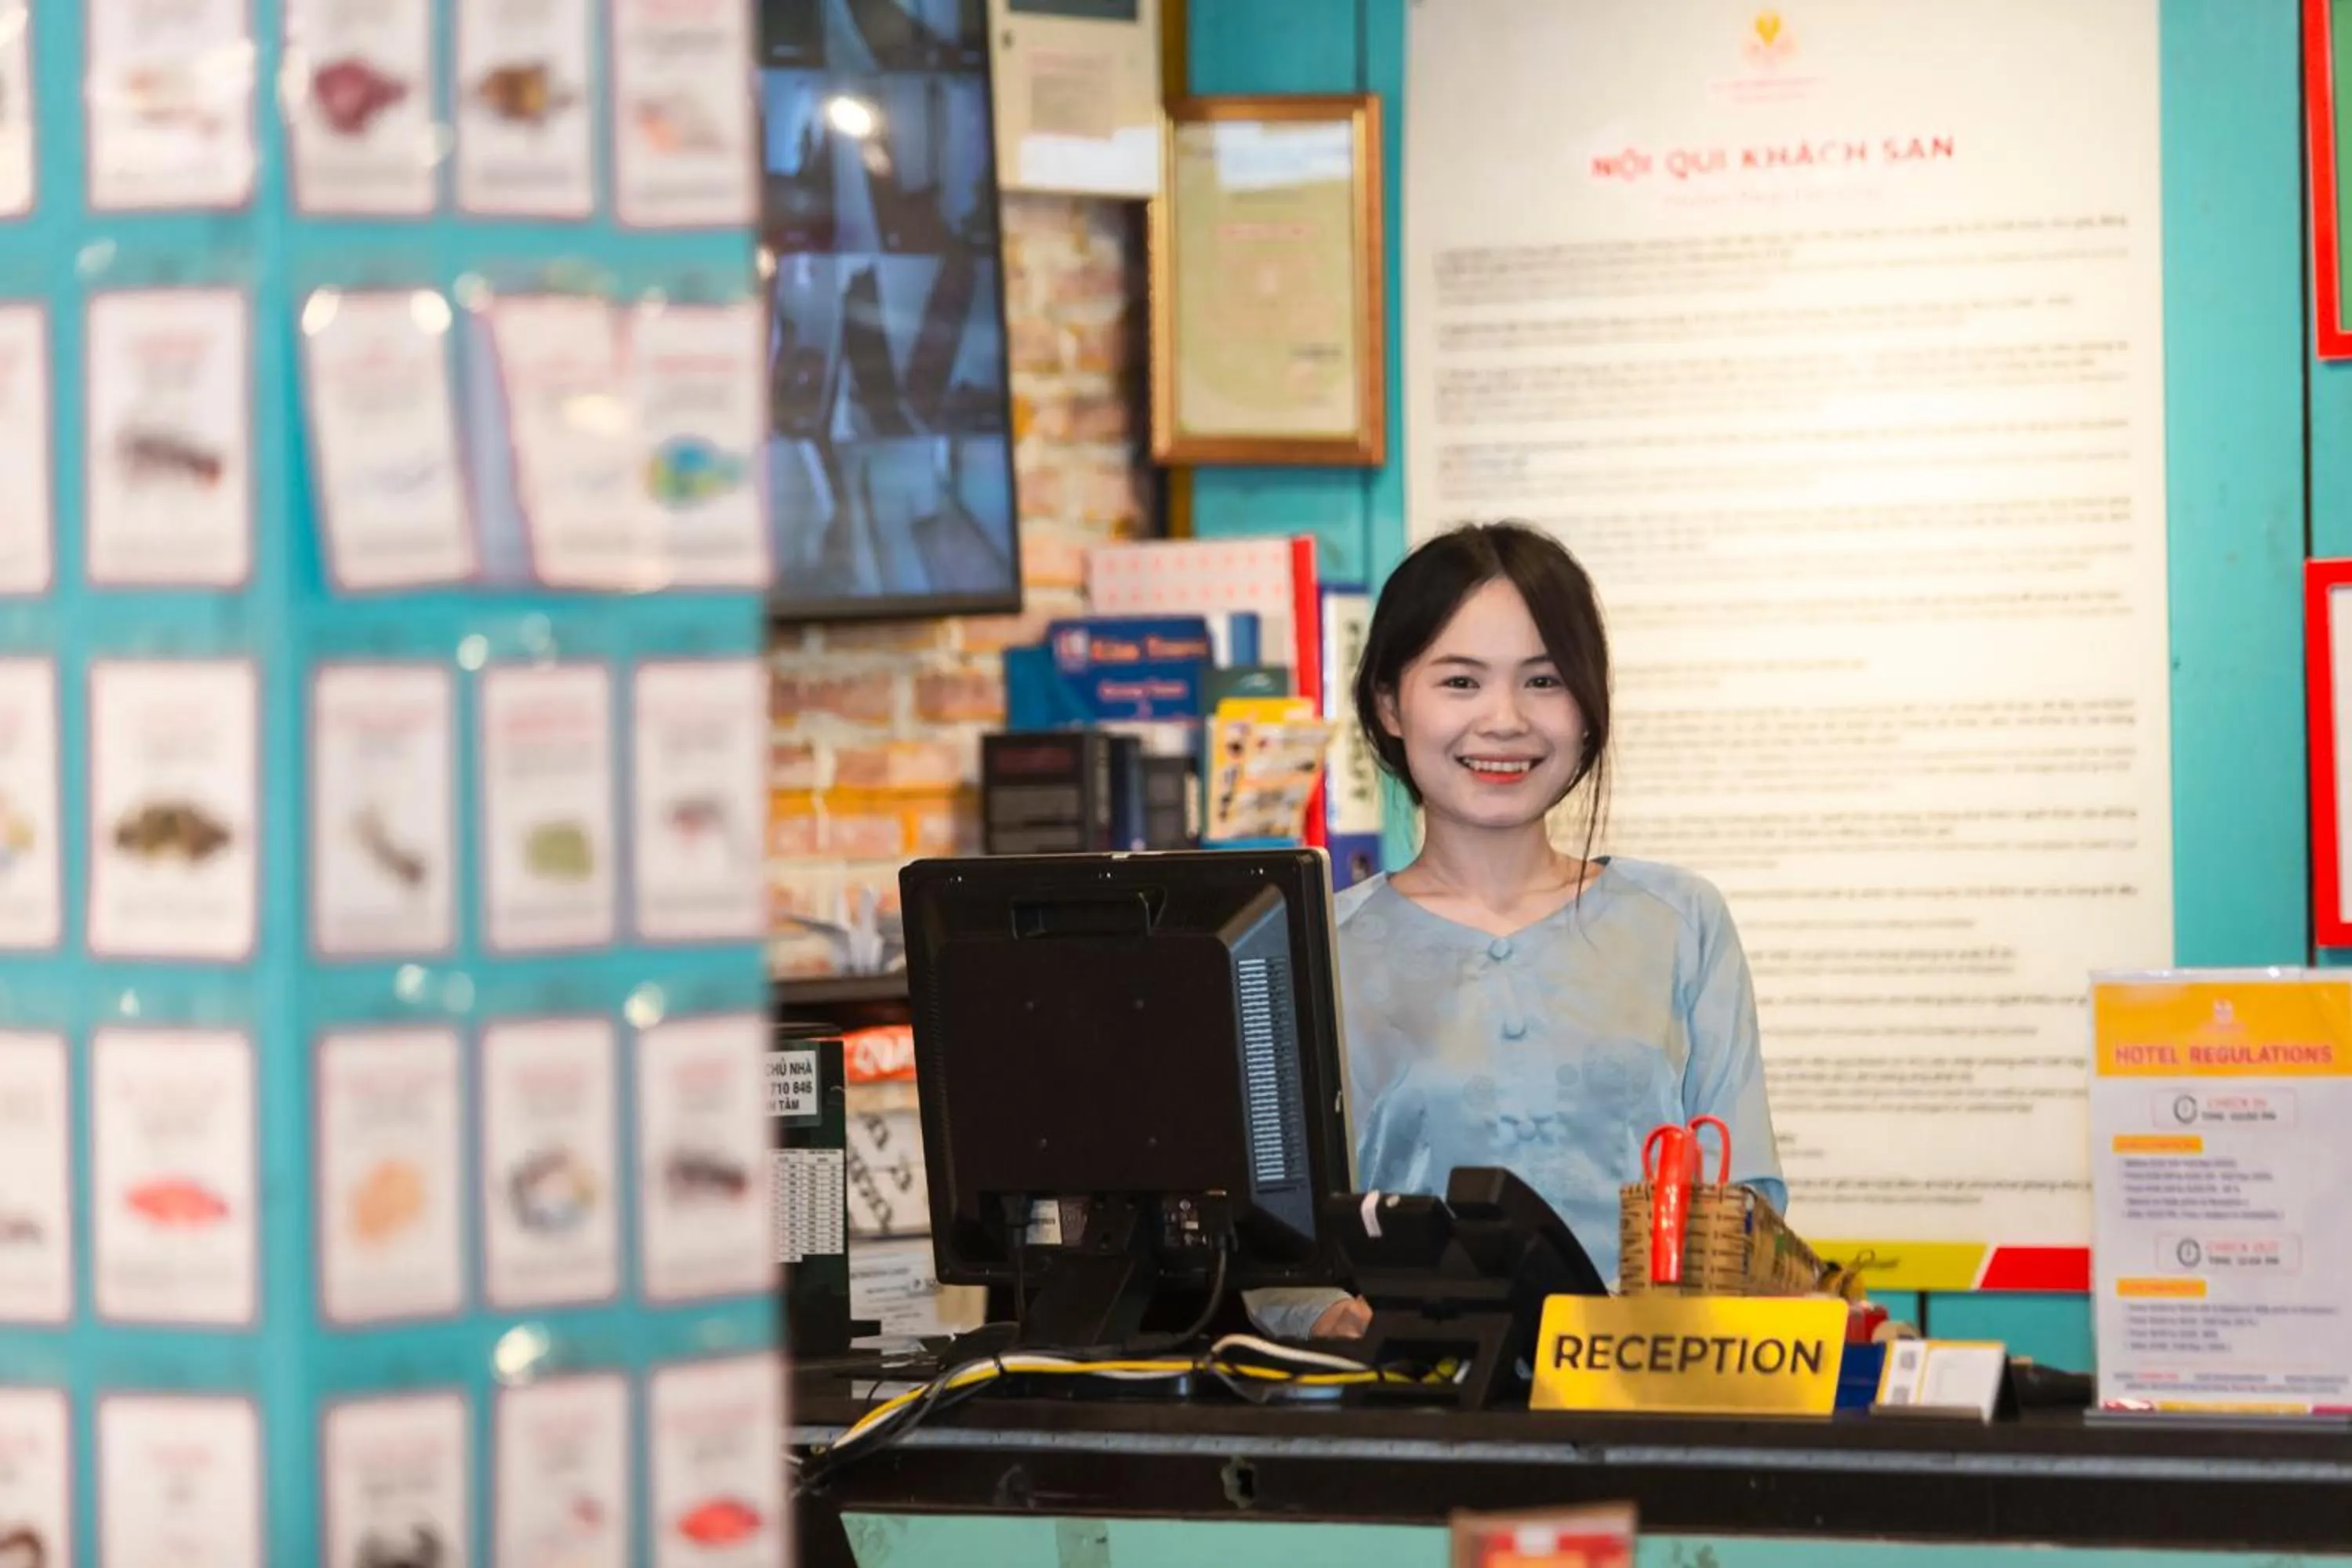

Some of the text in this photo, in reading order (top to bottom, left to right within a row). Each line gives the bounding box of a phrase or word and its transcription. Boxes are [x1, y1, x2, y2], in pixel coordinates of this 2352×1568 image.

[2115, 1044, 2333, 1065] HOTEL REGULATIONS
[1553, 1334, 1823, 1374] RECEPTION
